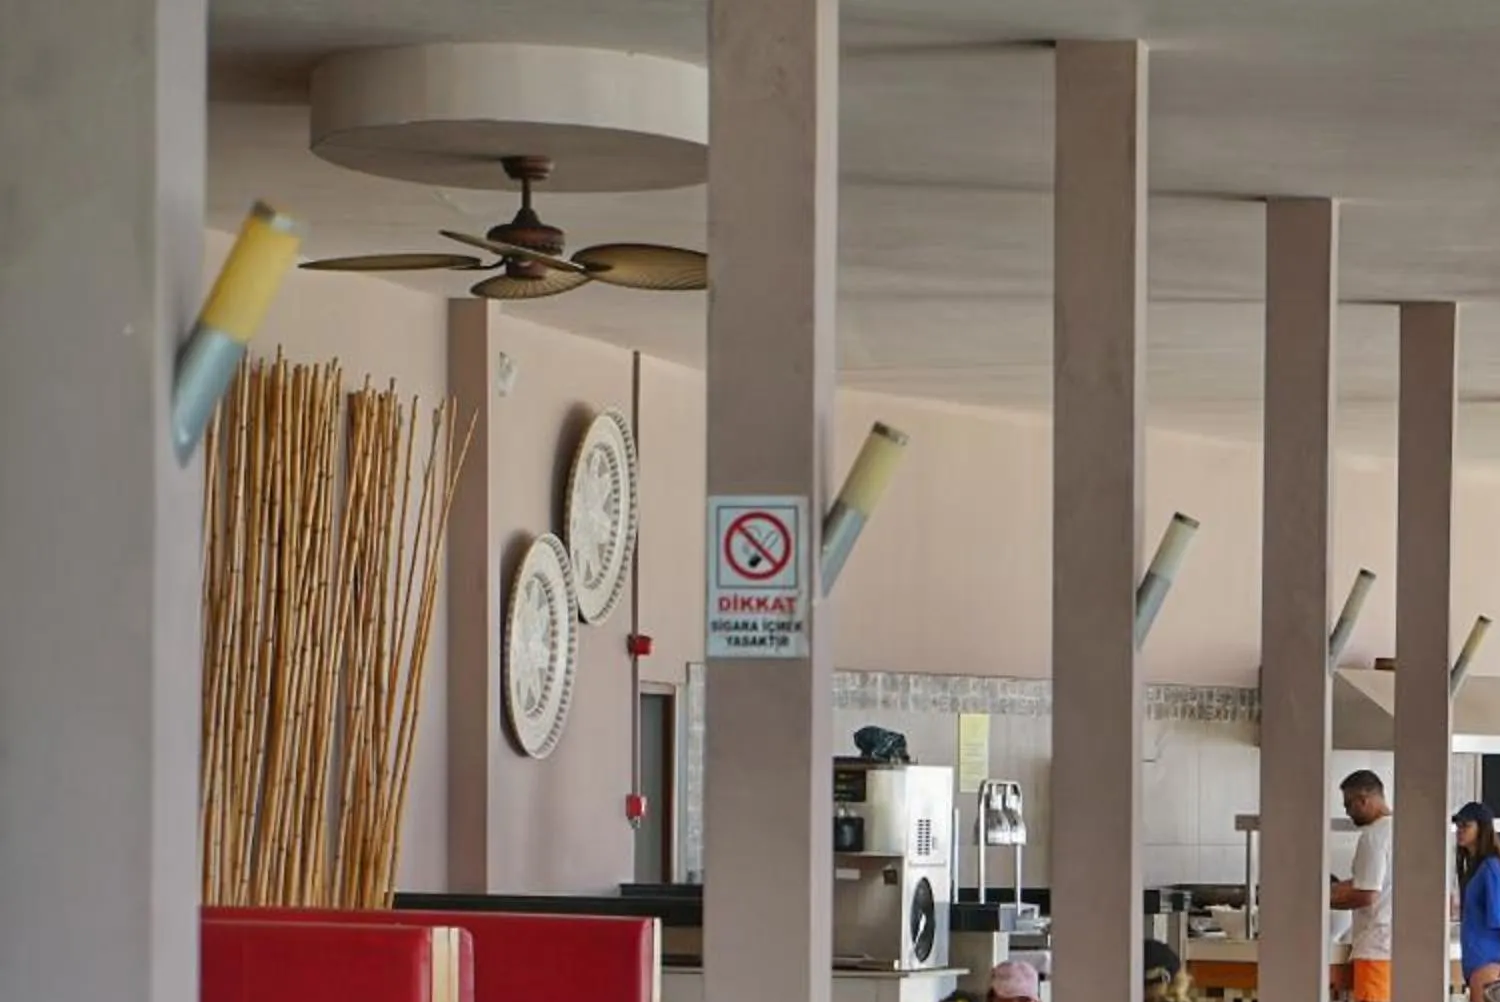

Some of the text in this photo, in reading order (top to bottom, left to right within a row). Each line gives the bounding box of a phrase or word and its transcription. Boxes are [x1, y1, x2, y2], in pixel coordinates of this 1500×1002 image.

[718, 594, 797, 612] DİKKAT
[711, 619, 803, 633] SİGARA İÇMEK
[726, 635, 789, 647] YASAKTIR
